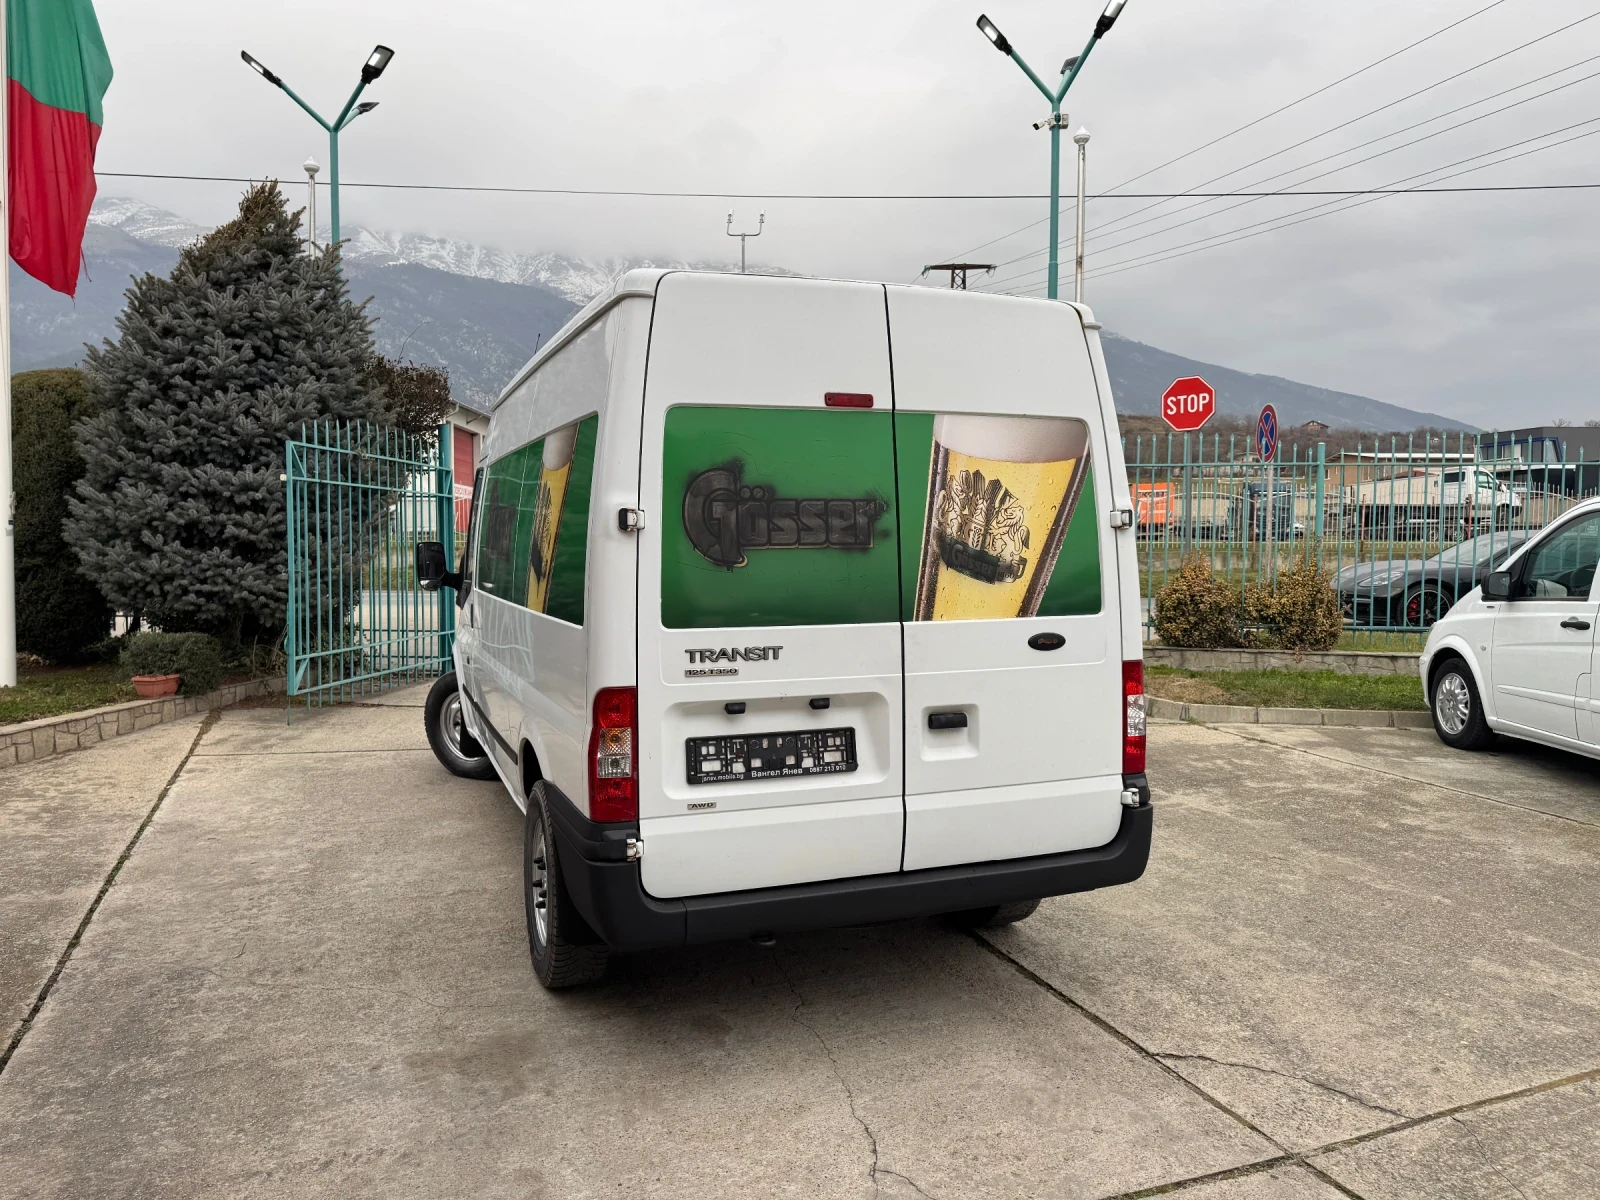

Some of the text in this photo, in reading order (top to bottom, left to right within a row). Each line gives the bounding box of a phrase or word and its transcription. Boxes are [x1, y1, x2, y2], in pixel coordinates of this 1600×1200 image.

[1166, 393, 1210, 415] STOP
[682, 467, 876, 568] Gösser
[684, 645, 784, 664] TRANSIT
[751, 768, 803, 778] Вангел Янев
